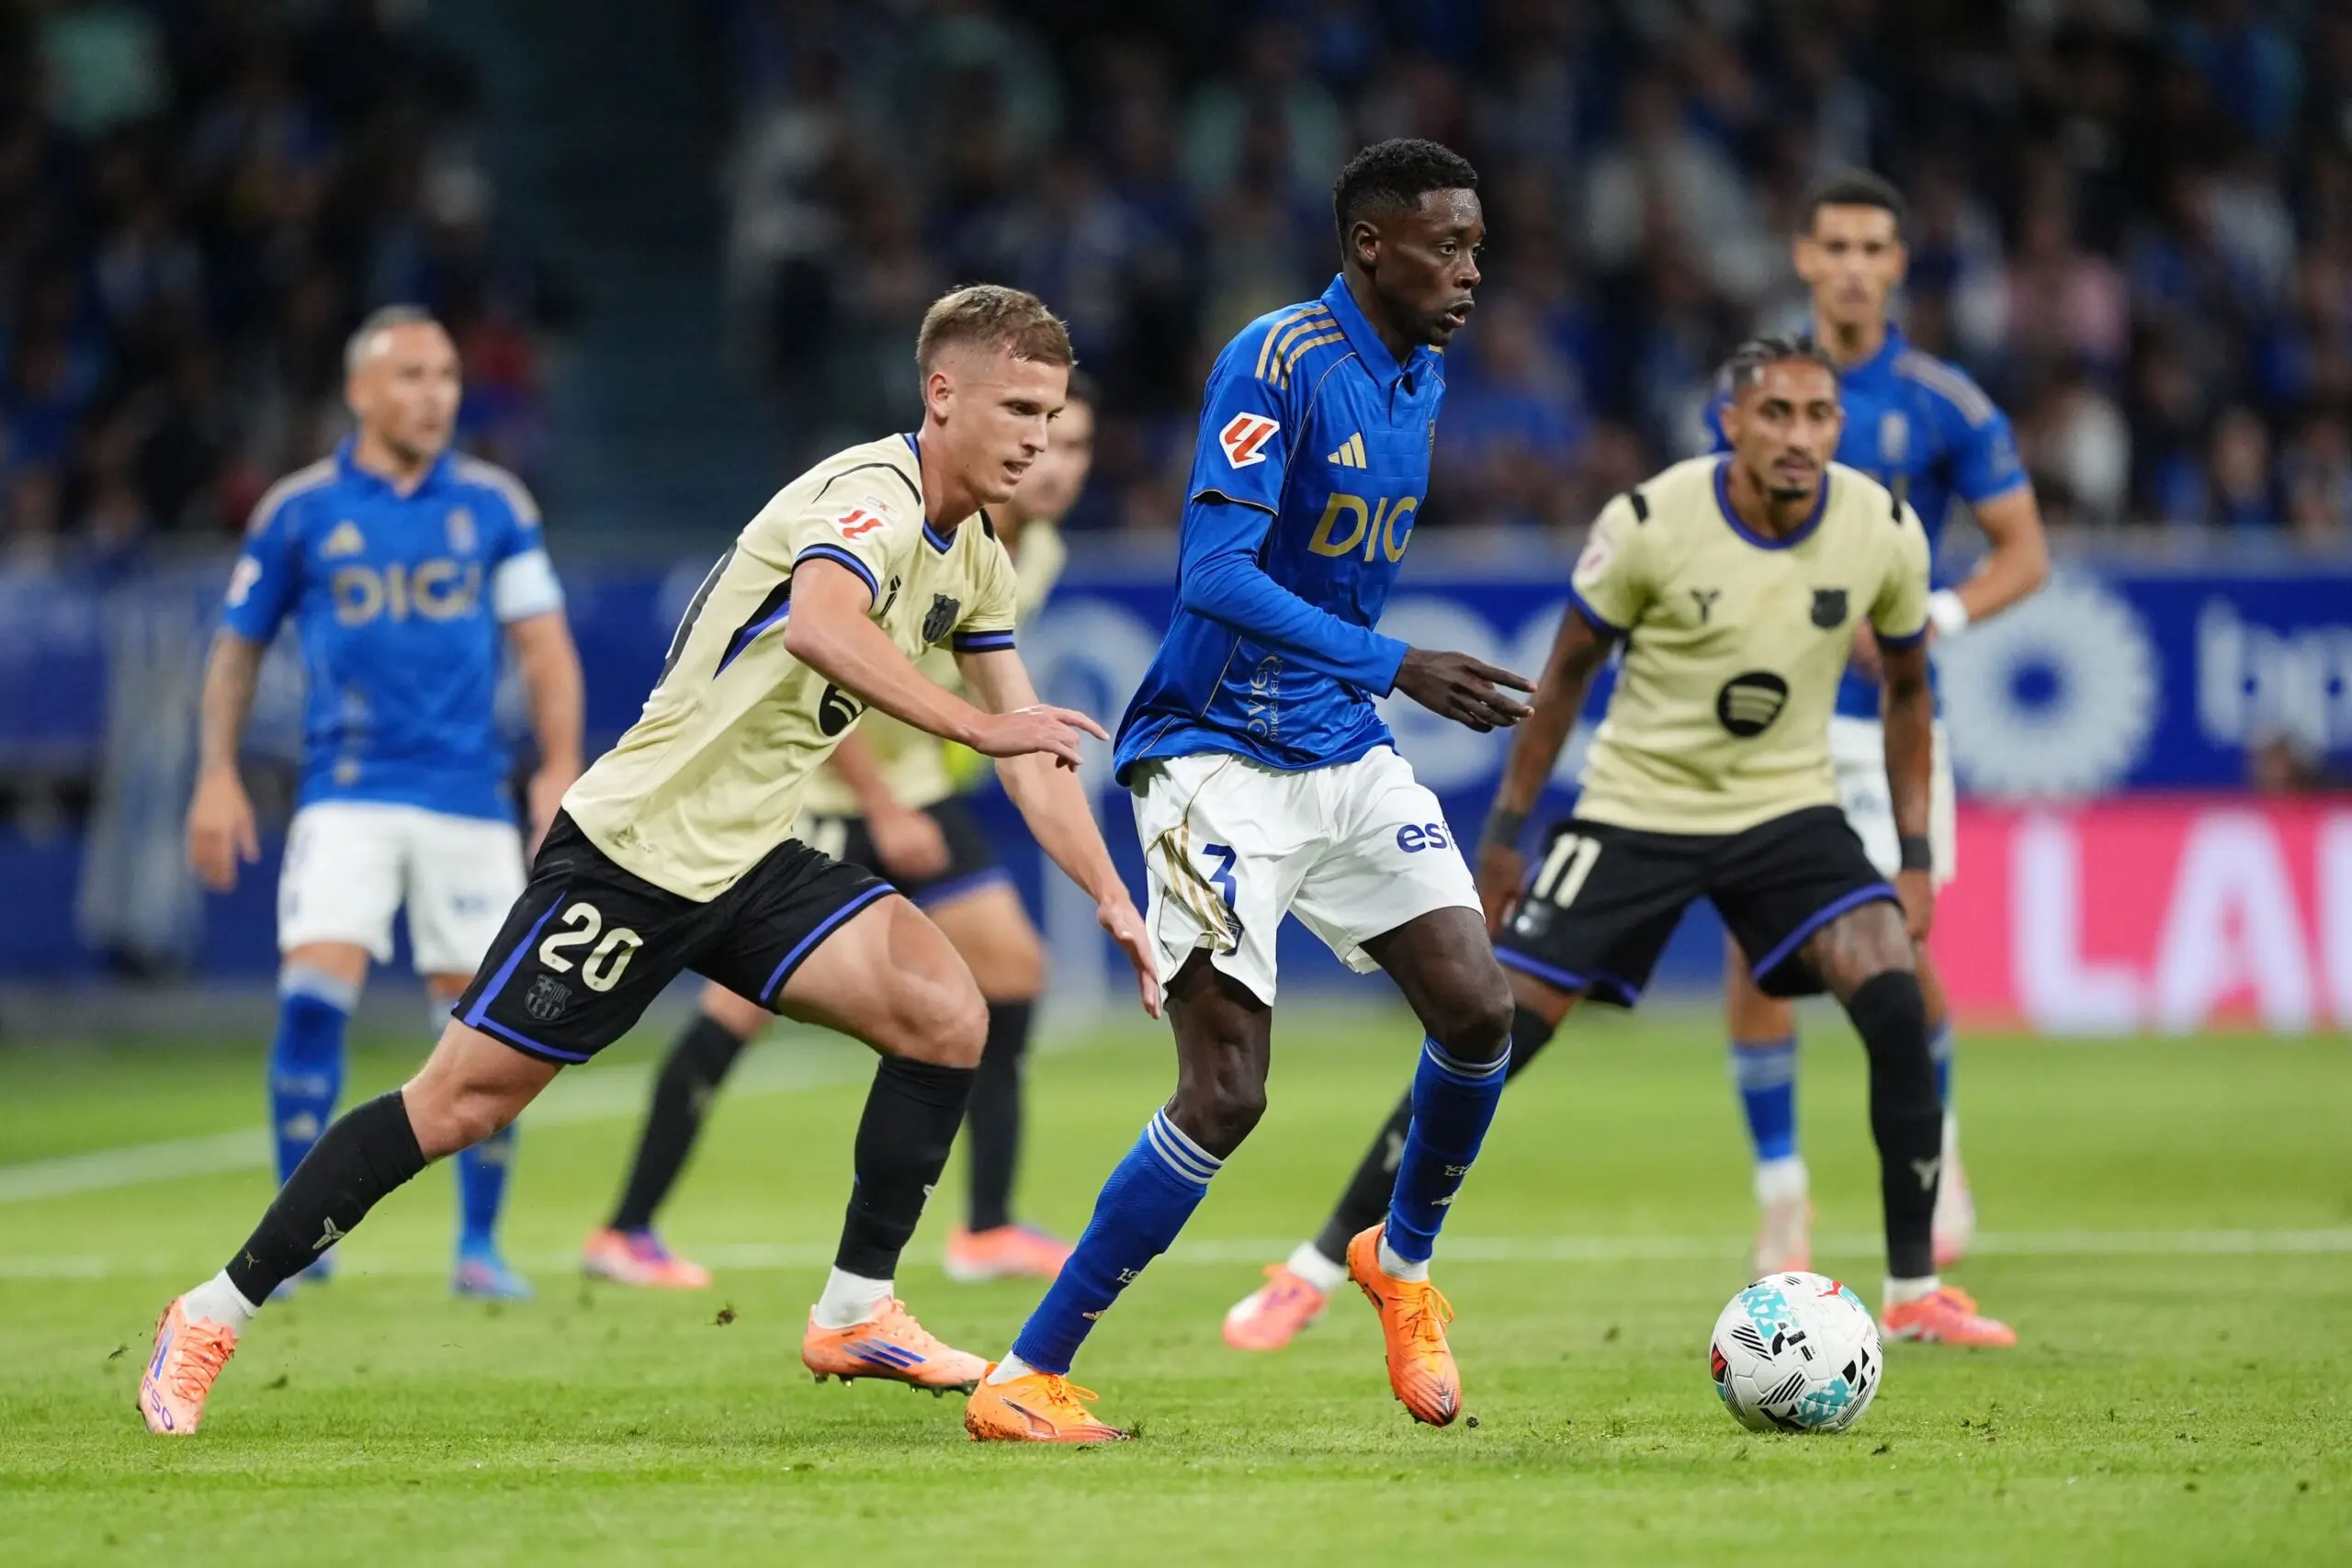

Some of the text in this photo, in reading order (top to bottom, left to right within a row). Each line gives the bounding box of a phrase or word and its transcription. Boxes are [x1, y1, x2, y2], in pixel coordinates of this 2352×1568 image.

[334, 559, 483, 628] DIGI
[1202, 843, 1238, 913] 3
[1532, 832, 1601, 909] 11
[539, 902, 644, 992] 20
